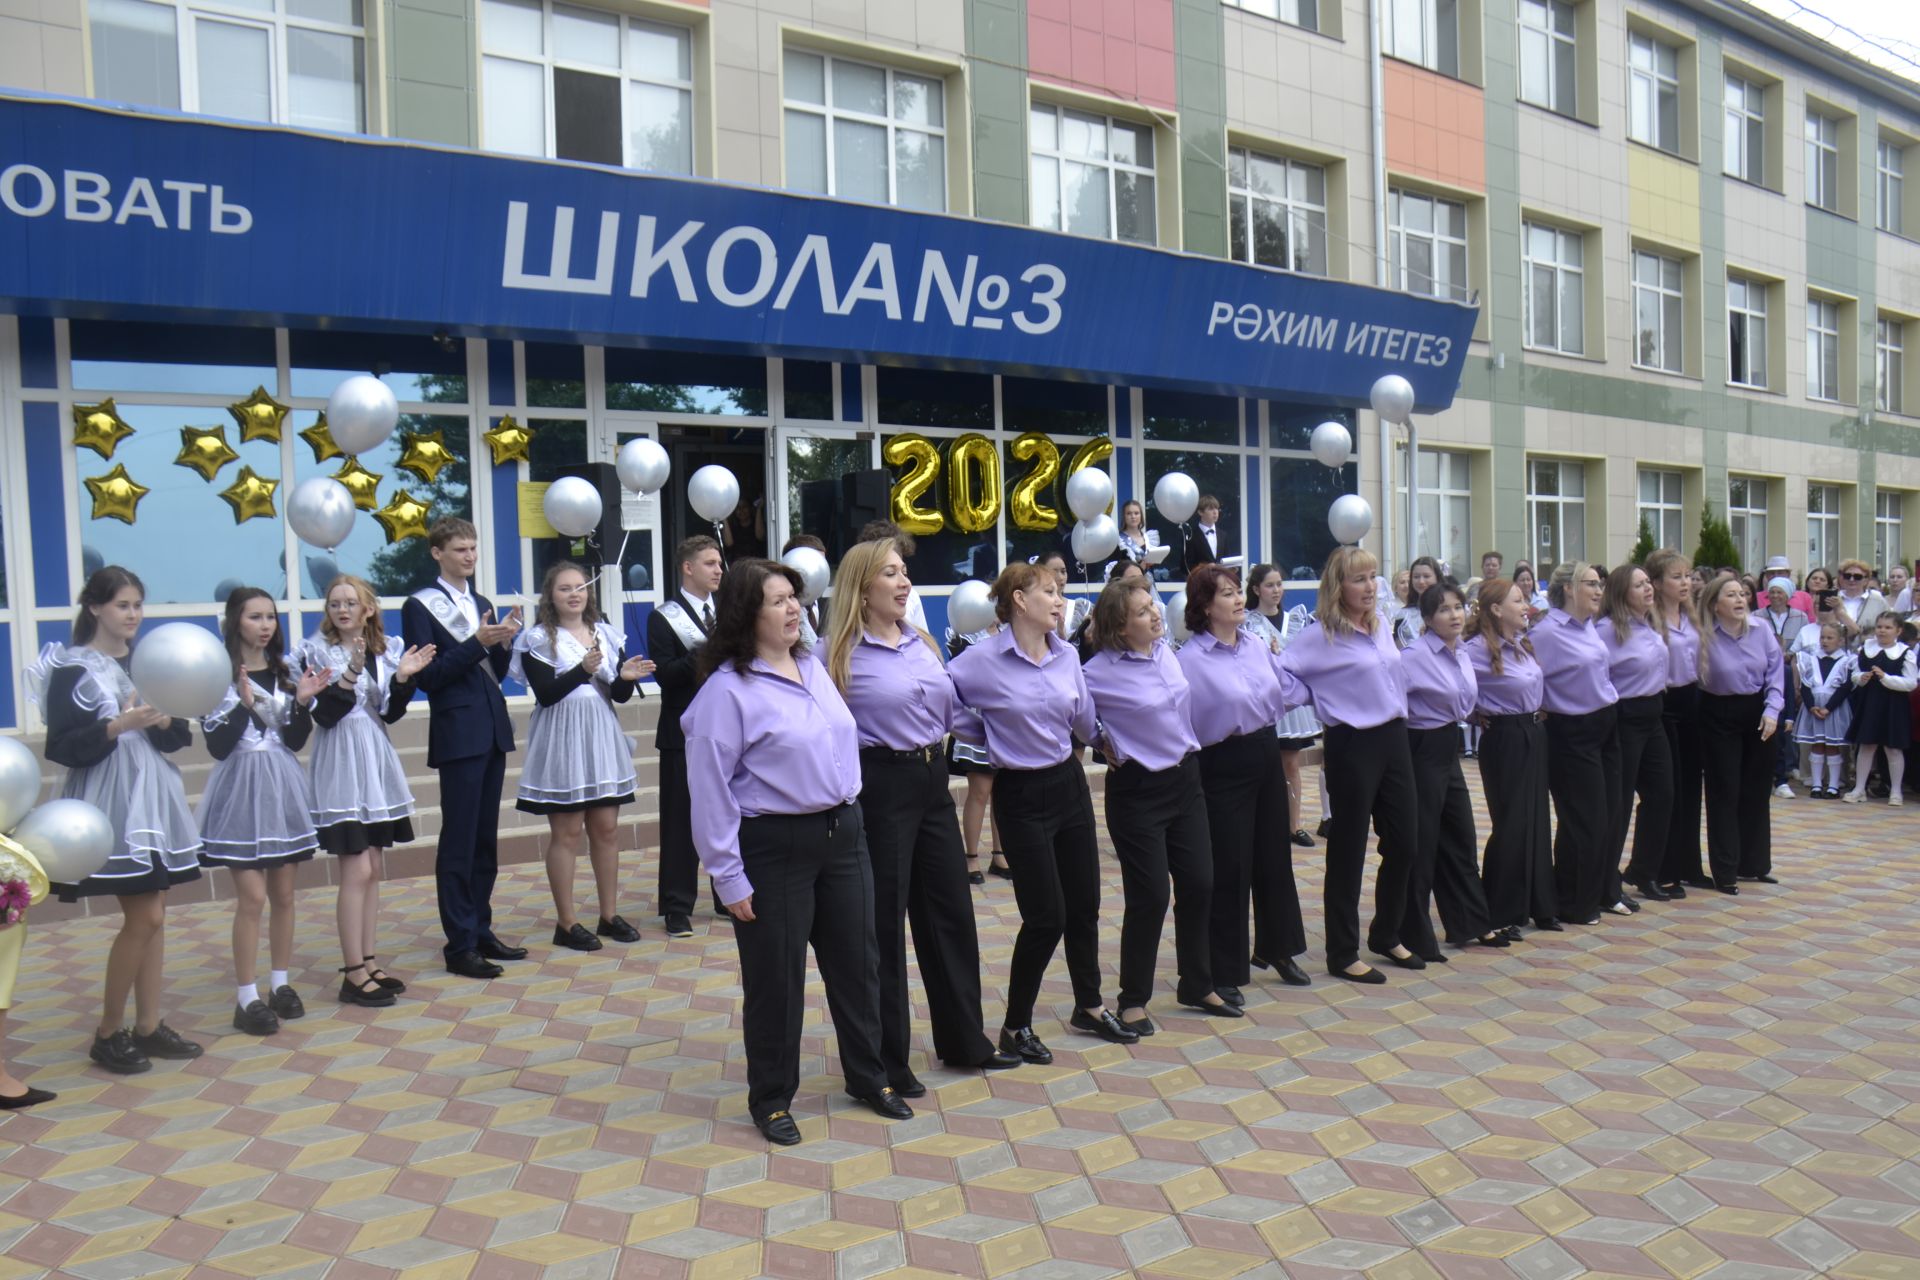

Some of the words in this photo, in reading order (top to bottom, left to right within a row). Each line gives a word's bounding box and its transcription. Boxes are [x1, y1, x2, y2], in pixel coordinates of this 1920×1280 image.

[0, 164, 254, 235] ОВАТЬ
[1207, 301, 1339, 352] РӘХИМ
[1344, 321, 1453, 368] ИТЕГЕЗ
